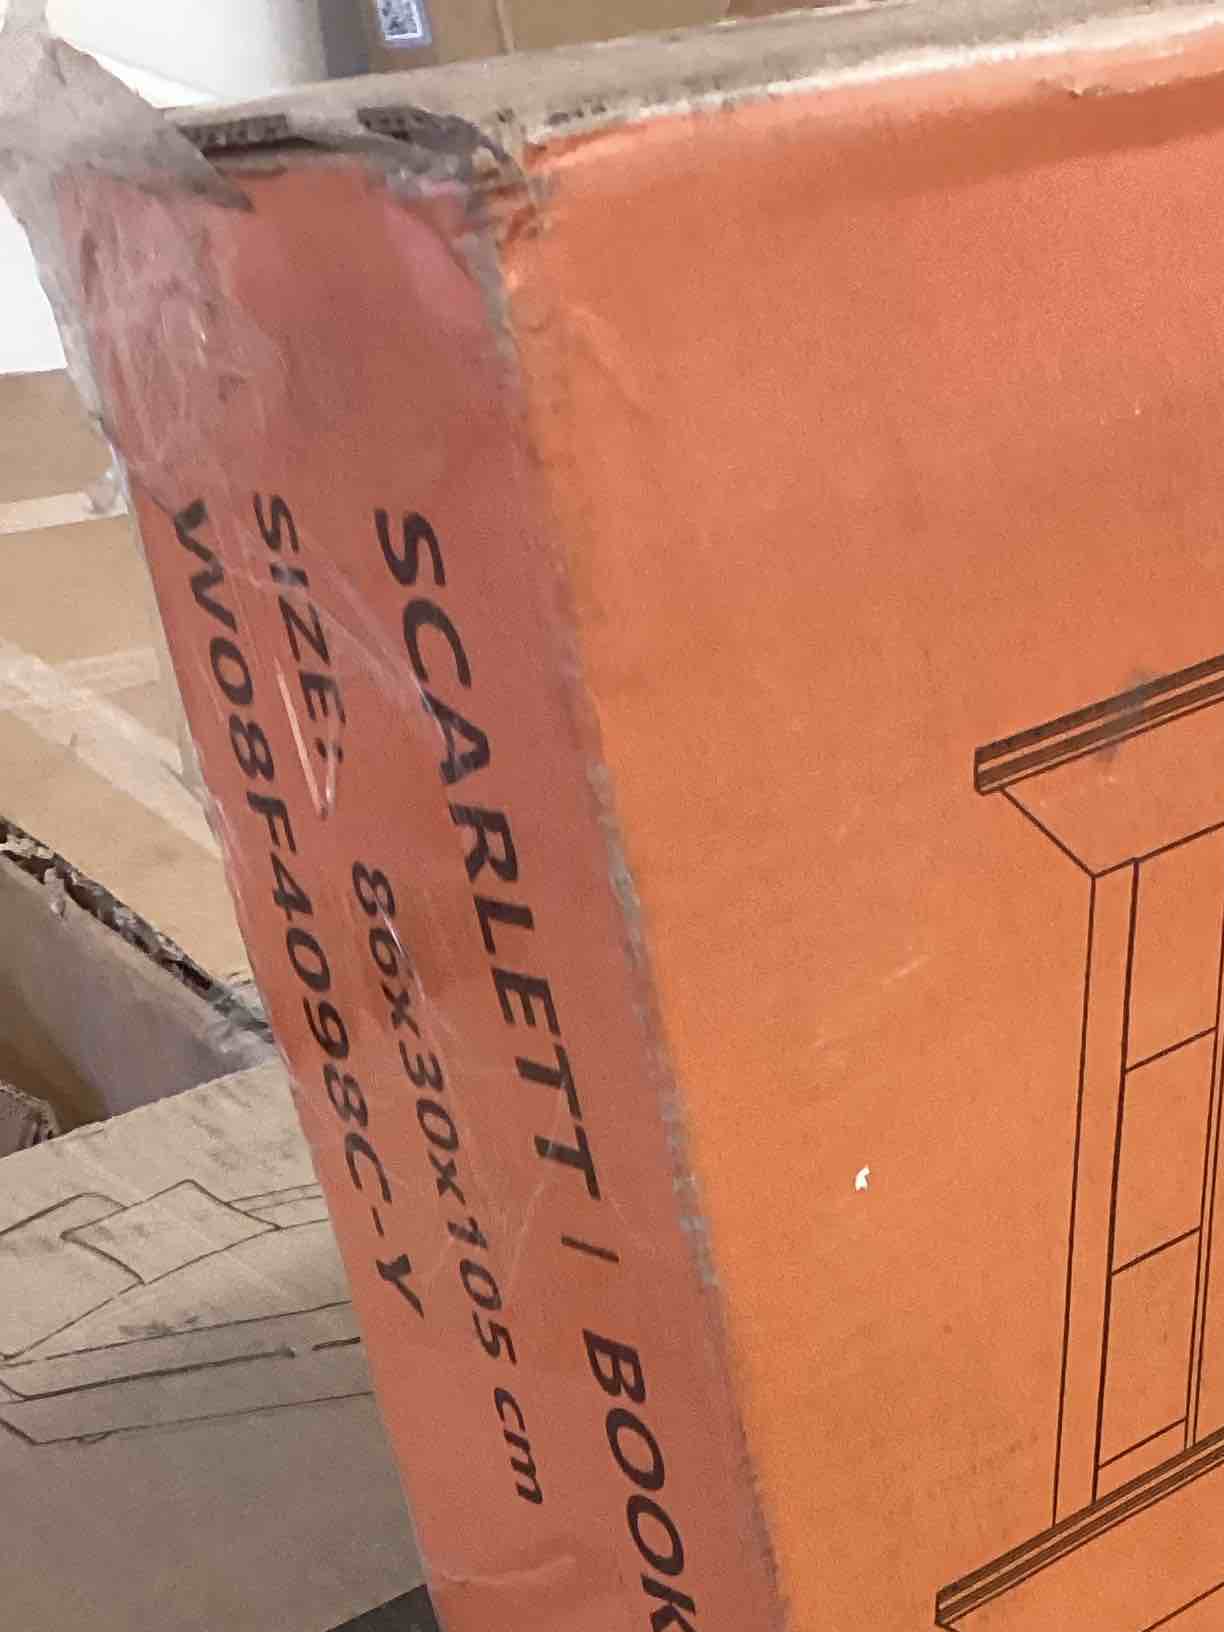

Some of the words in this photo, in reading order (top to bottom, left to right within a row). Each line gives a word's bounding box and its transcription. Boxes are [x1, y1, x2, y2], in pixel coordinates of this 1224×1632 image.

[252, 491, 346, 764] SIZE:
[351, 860, 518, 1365] 86x30x105
[493, 1386, 544, 1505] cm
[374, 508, 602, 1201] SCARLETT
